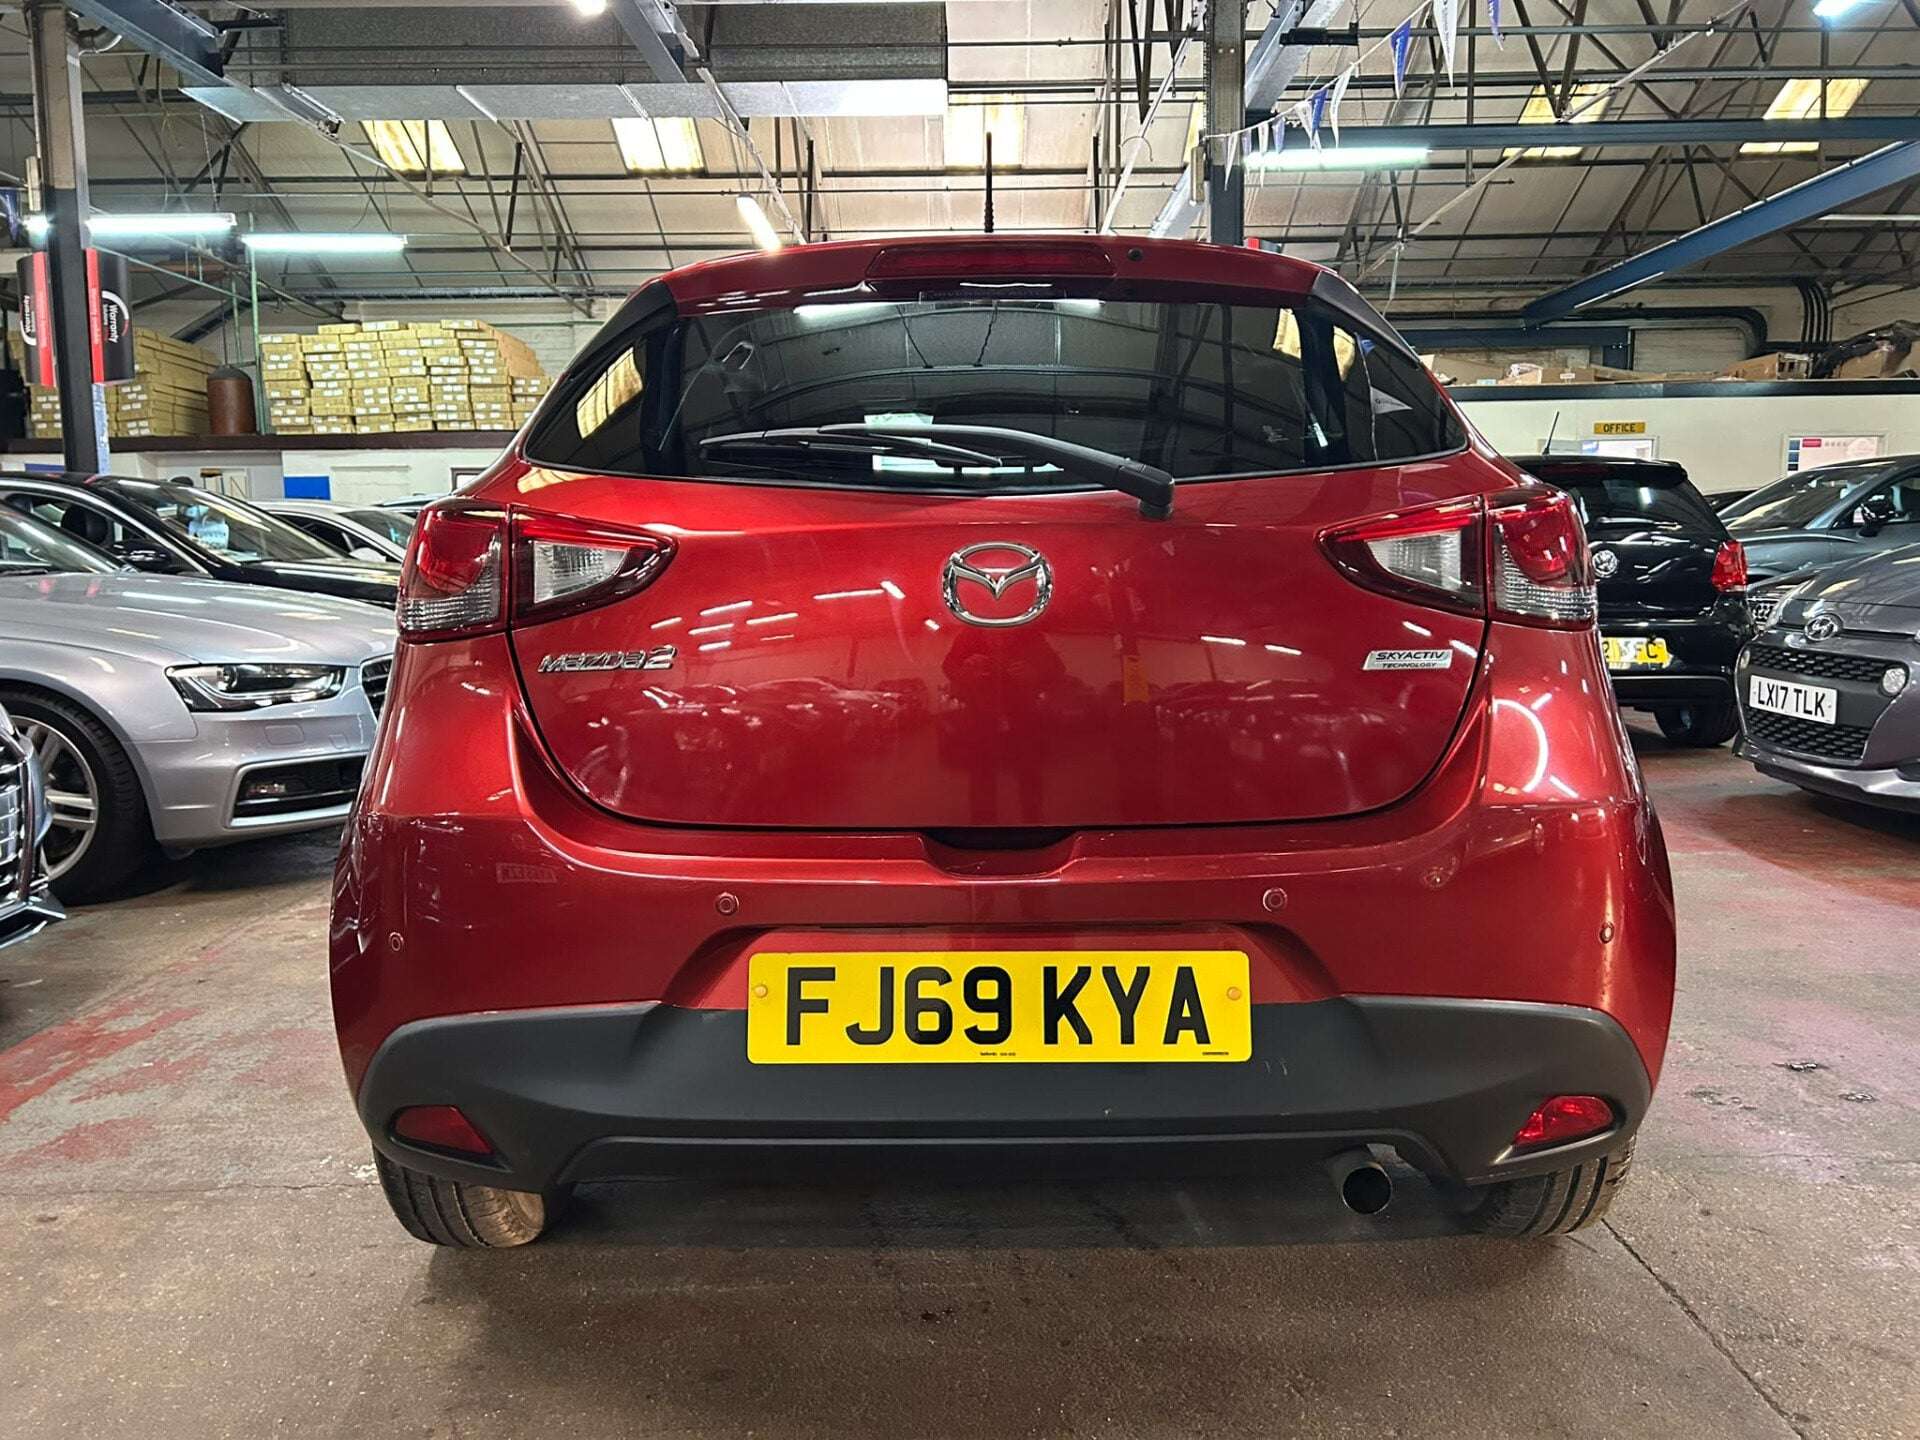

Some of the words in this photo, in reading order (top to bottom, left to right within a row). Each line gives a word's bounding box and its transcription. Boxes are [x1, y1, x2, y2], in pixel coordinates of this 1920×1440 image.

[108, 304, 119, 343] Warranty
[1603, 423, 1636, 433] OFFICE
[1376, 651, 1446, 661] SKYACTIV
[1758, 681, 1789, 710] LX17
[1793, 688, 1826, 718] TLK
[785, 965, 1013, 1047] FJ69
[1042, 965, 1212, 1047] KYA
